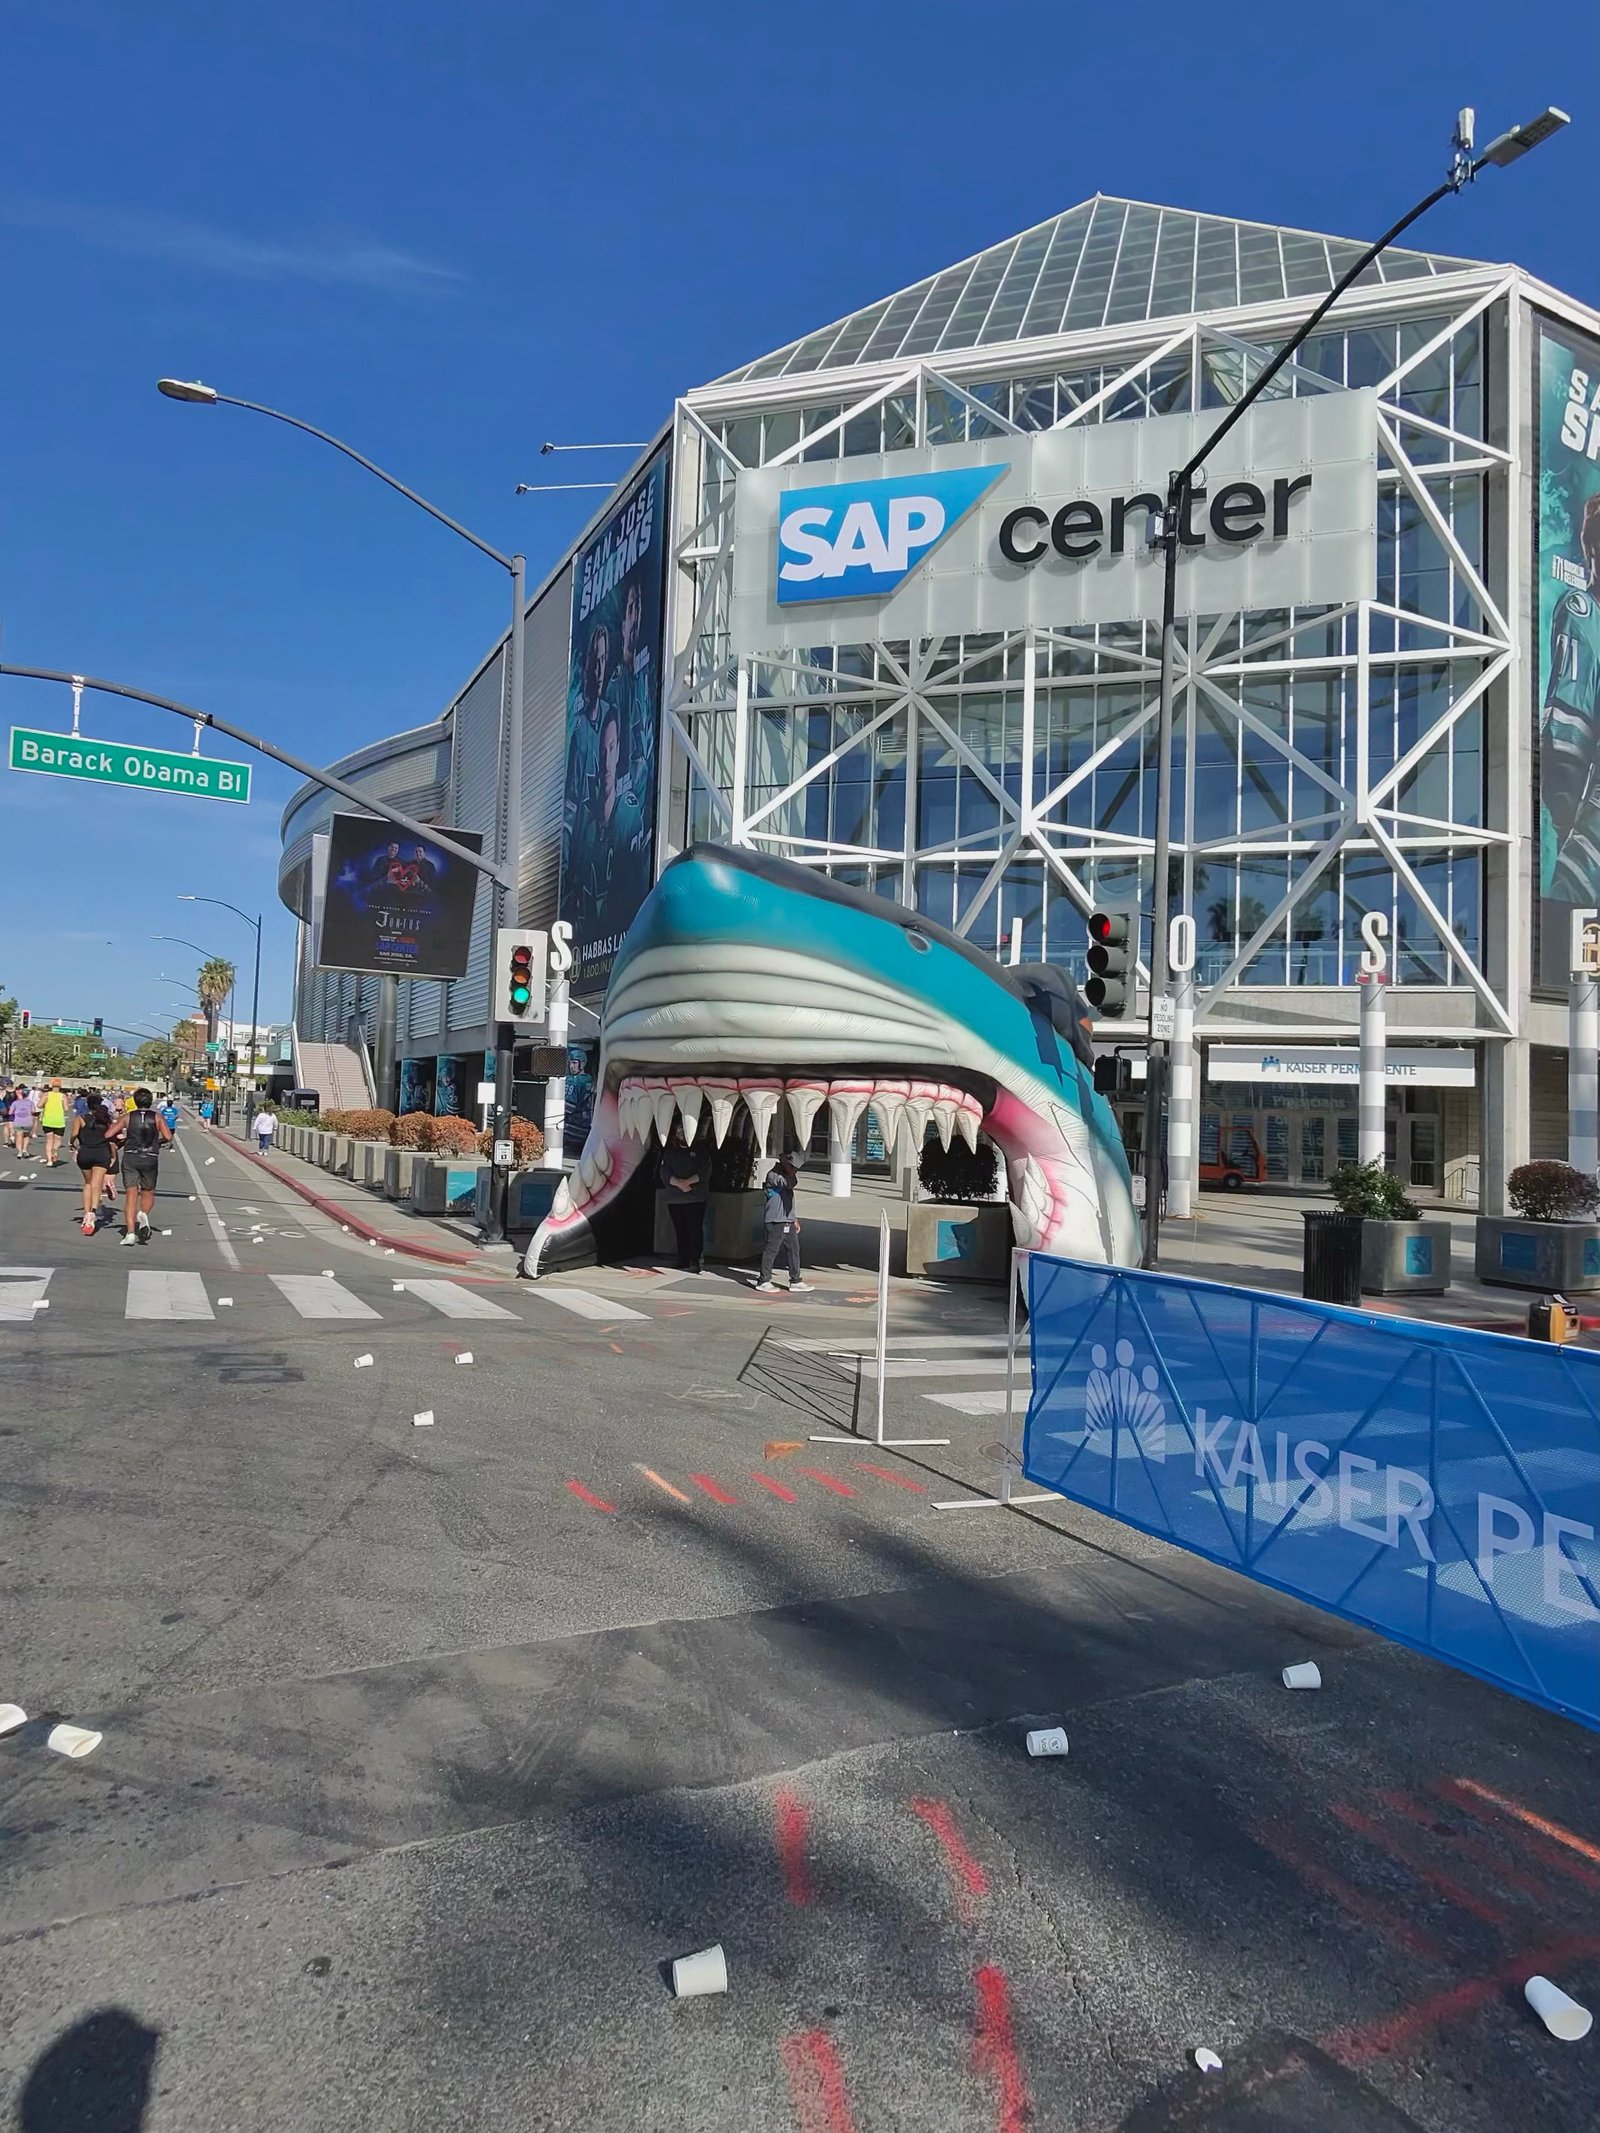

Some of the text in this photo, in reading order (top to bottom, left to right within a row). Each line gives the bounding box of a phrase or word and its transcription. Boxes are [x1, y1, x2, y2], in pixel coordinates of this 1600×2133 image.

[583, 474, 657, 585] SAN JOSE
[779, 473, 1312, 582] SAP center
[579, 507, 653, 622] SHARKS
[21, 739, 241, 793] Barack Obama Bl
[550, 920, 573, 972] S
[582, 936, 613, 962] HABBAS
[1153, 1013, 1174, 1023] PEDDLING
[1157, 1023, 1170, 1034] ZONE
[1160, 1003, 1169, 1012] NO
[1286, 1062, 1328, 1074] KAISER
[1193, 1407, 1600, 1623] KAISER PE
